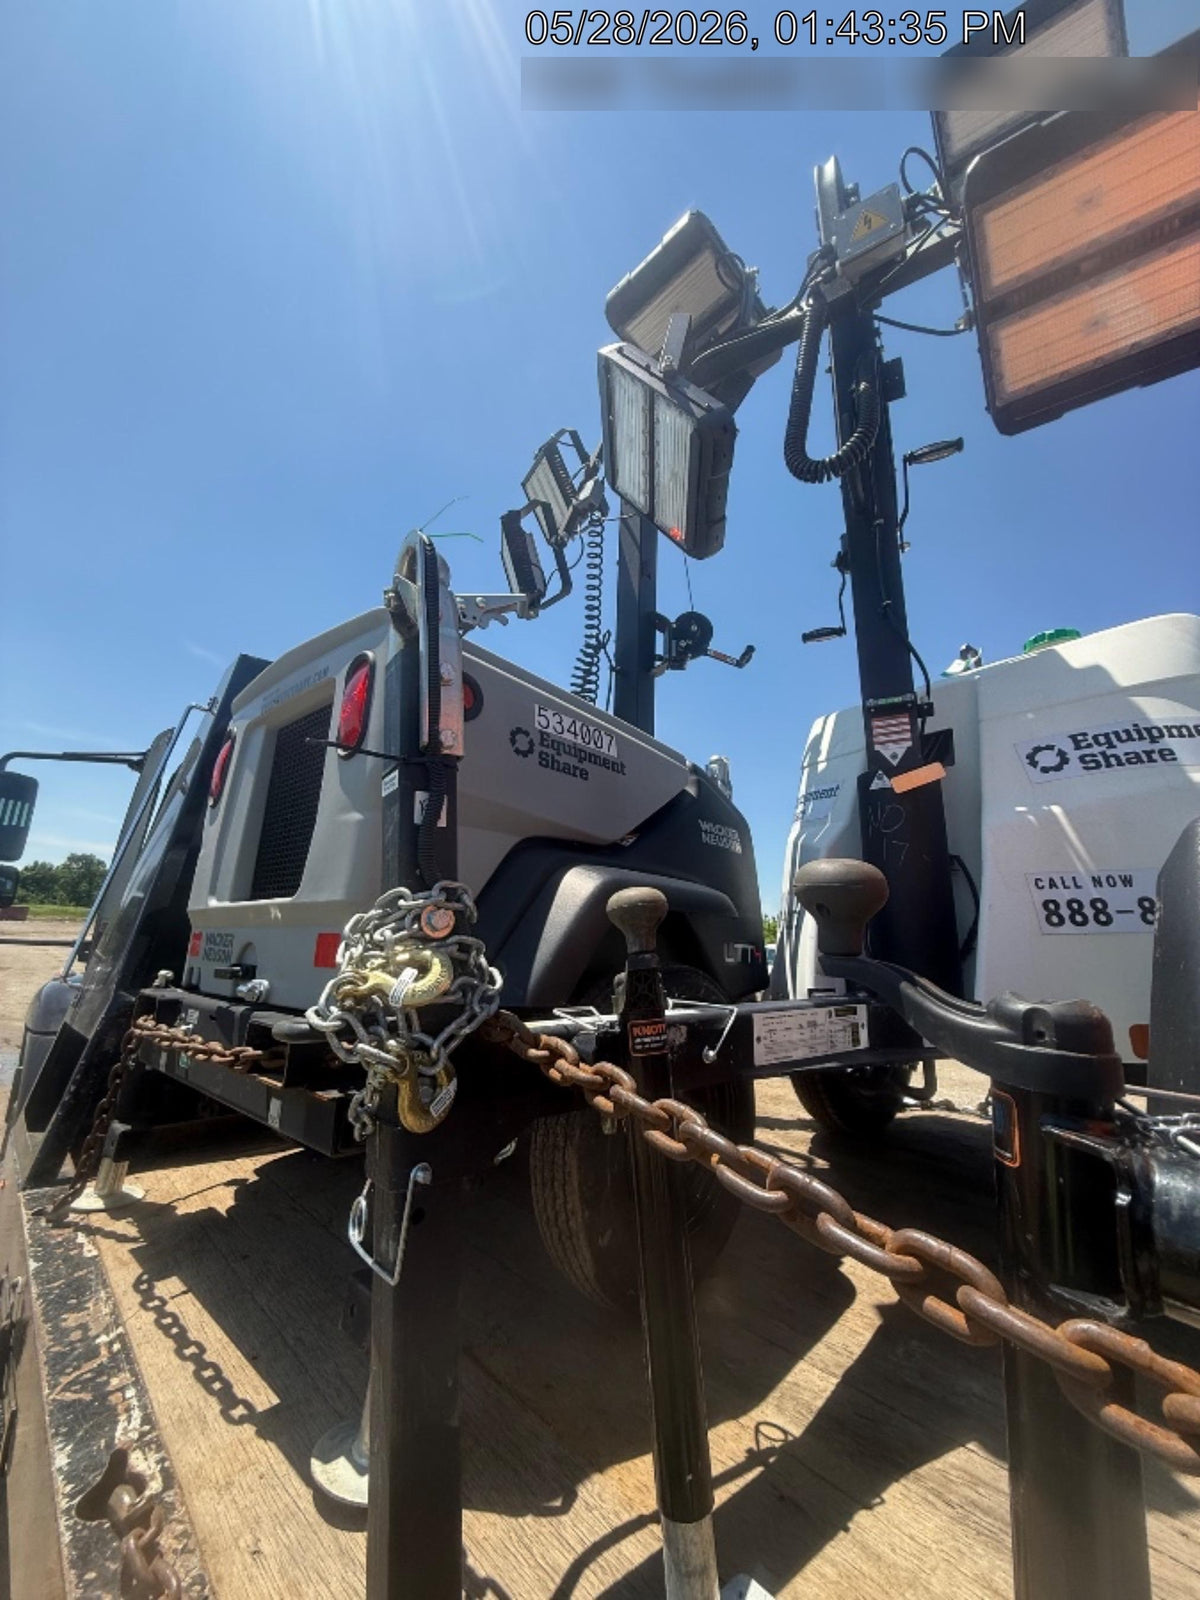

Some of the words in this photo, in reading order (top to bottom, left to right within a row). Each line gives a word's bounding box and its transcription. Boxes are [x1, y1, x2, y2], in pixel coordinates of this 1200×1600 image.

[537, 705, 614, 753] 534007
[538, 750, 589, 781] Share
[539, 730, 627, 776] Equipment
[1078, 747, 1178, 771] Share
[1034, 876, 1083, 890] CALL
[1092, 874, 1134, 889] NOW
[1041, 896, 1157, 928] 888-8
